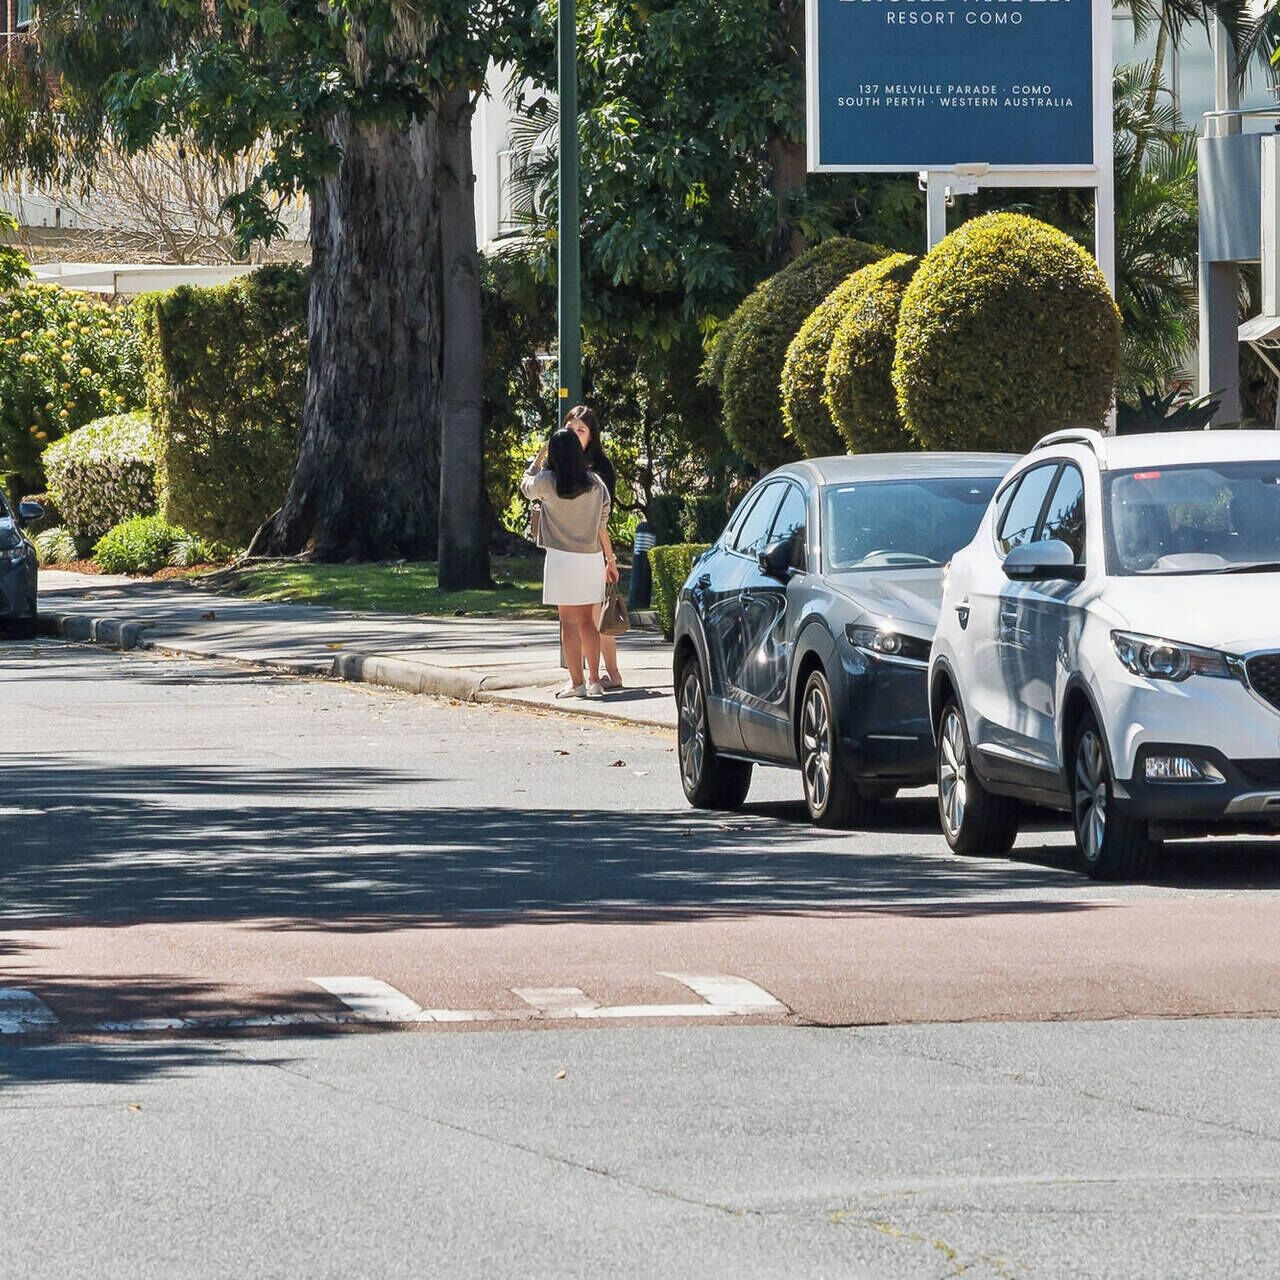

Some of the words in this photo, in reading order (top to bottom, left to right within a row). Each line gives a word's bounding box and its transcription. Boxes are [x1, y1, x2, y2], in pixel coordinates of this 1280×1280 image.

[886, 11, 956, 25] RESORT
[965, 11, 1023, 25] COMO
[858, 84, 879, 95] 137
[885, 84, 942, 95] MELVILLE
[948, 84, 997, 95] PARADE
[1011, 84, 1052, 95] COMO
[837, 96, 881, 107] SOUTH
[886, 96, 926, 107] PERTH
[939, 96, 998, 107] WESTERN
[1004, 96, 1073, 107] AUSTRALIA
